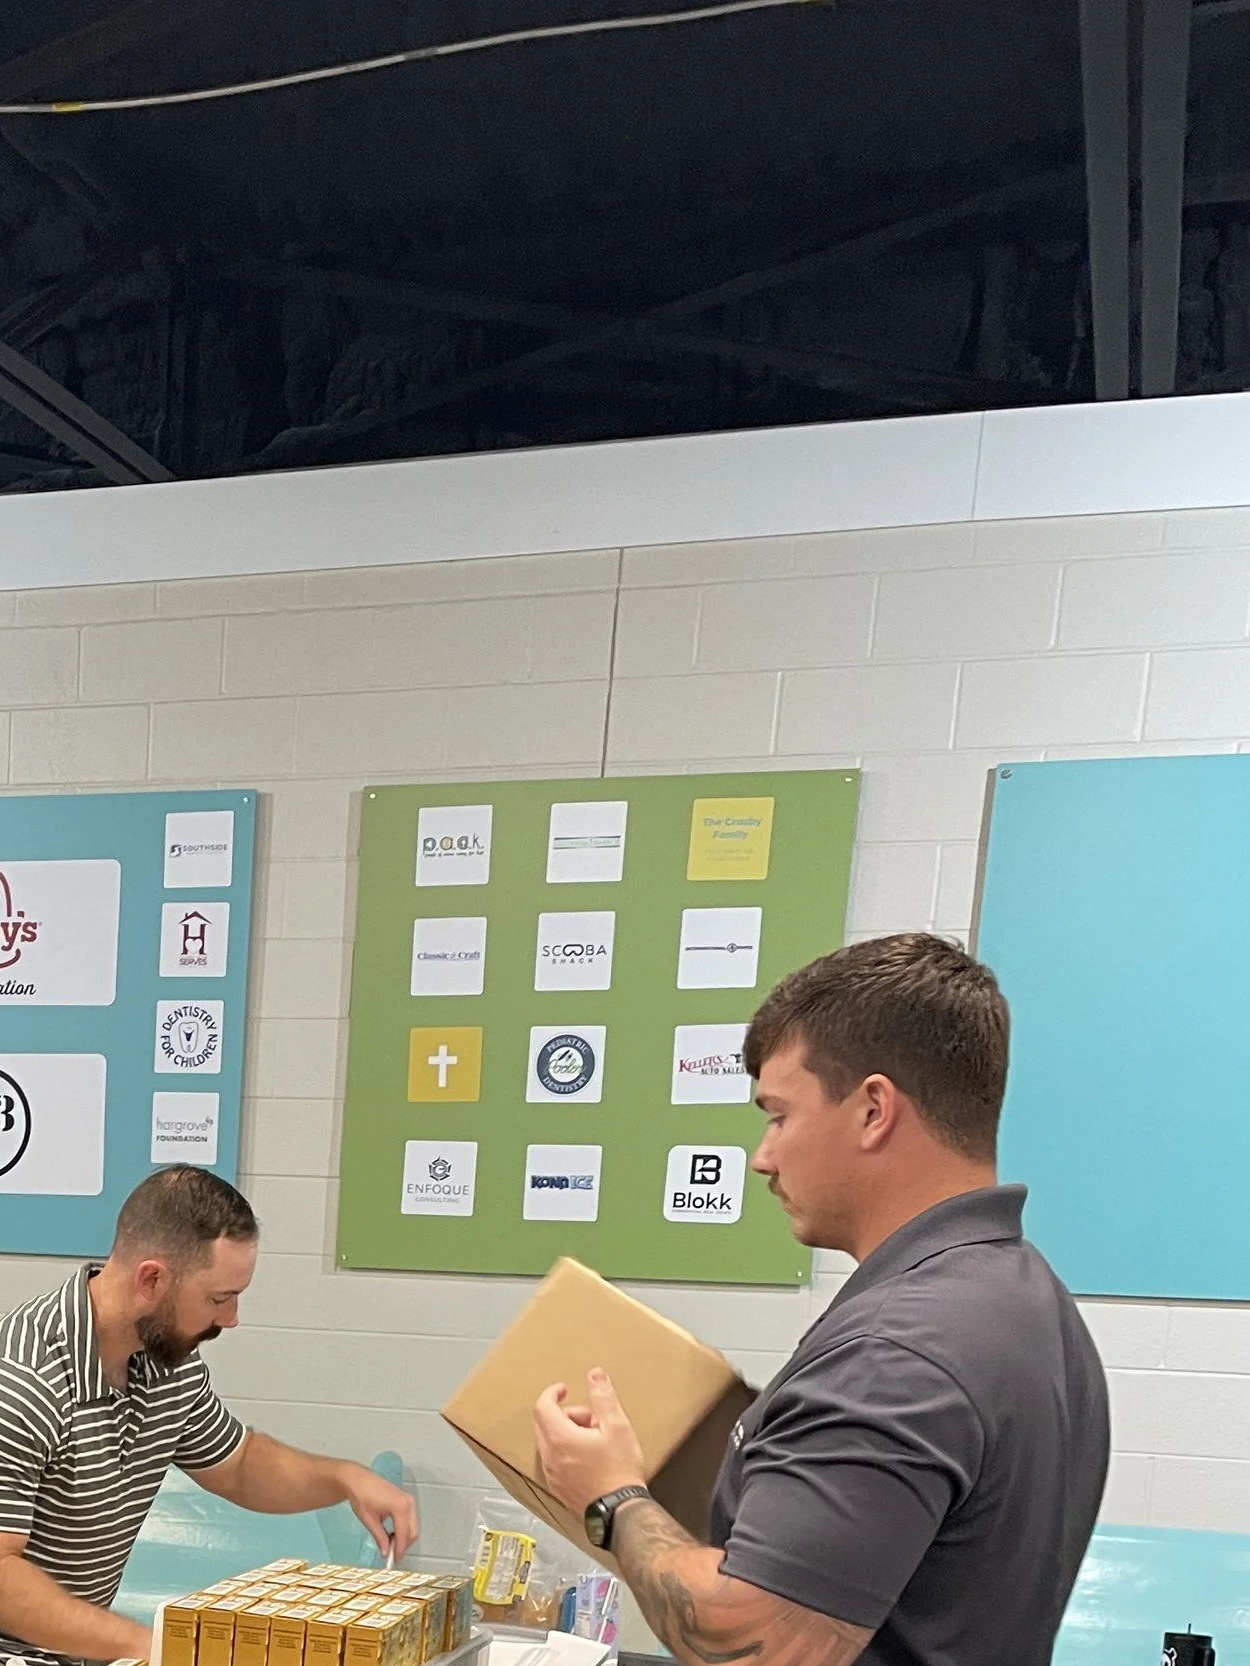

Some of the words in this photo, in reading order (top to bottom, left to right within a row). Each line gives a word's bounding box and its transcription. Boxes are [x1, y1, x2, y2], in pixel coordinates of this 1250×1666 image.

[183, 843, 228, 853] SOUTHSIDE
[179, 958, 207, 966] SERVES
[162, 1005, 218, 1032] DENTISTRY
[161, 1034, 174, 1058] FOR
[173, 1033, 218, 1068] CHILDREN
[547, 1036, 588, 1054] PEDIATRIC
[543, 1075, 588, 1092] DENTISTRY
[156, 1116, 207, 1134] hargrove
[156, 1135, 207, 1143] FOUNDATION
[407, 1184, 470, 1196] ENFOQUE
[673, 1192, 732, 1210] Blokk
